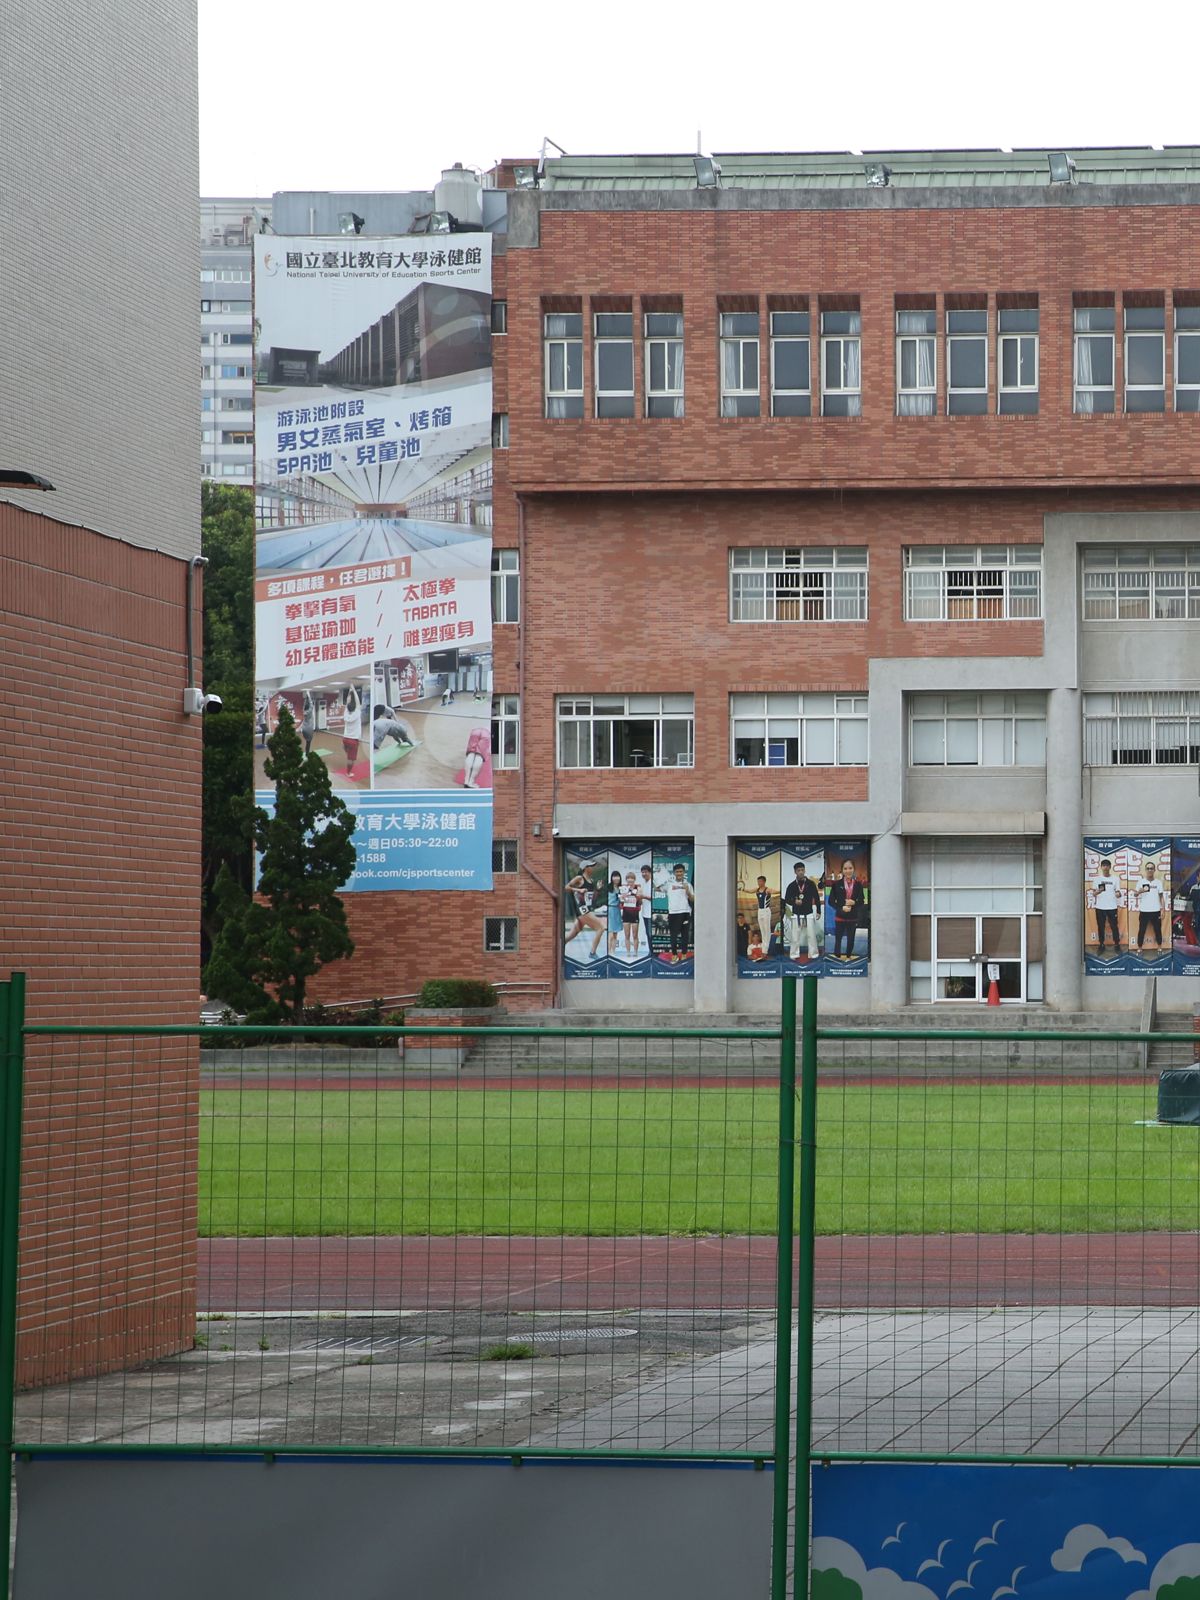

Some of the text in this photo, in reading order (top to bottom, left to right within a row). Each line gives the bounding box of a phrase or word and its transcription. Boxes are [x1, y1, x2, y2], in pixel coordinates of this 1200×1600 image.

[286, 247, 482, 269] 國立臺北教育大學泳健館
[319, 271, 341, 279] Taipei
[342, 271, 380, 279] University
[430, 268, 455, 278] Sports
[456, 267, 481, 276] Center
[277, 399, 365, 428] 游泳池附設
[277, 406, 452, 452] 男女蒸氣室、烤箱
[277, 437, 421, 475] SPA池、兒童池
[285, 594, 356, 621] 拳擊有氧
[403, 578, 456, 602] 太極拳
[285, 617, 356, 645] 基礎瑜珈
[403, 601, 457, 622] TABATA
[285, 637, 375, 667] 幼兒體適能
[403, 621, 474, 648] 雕塑瘦身
